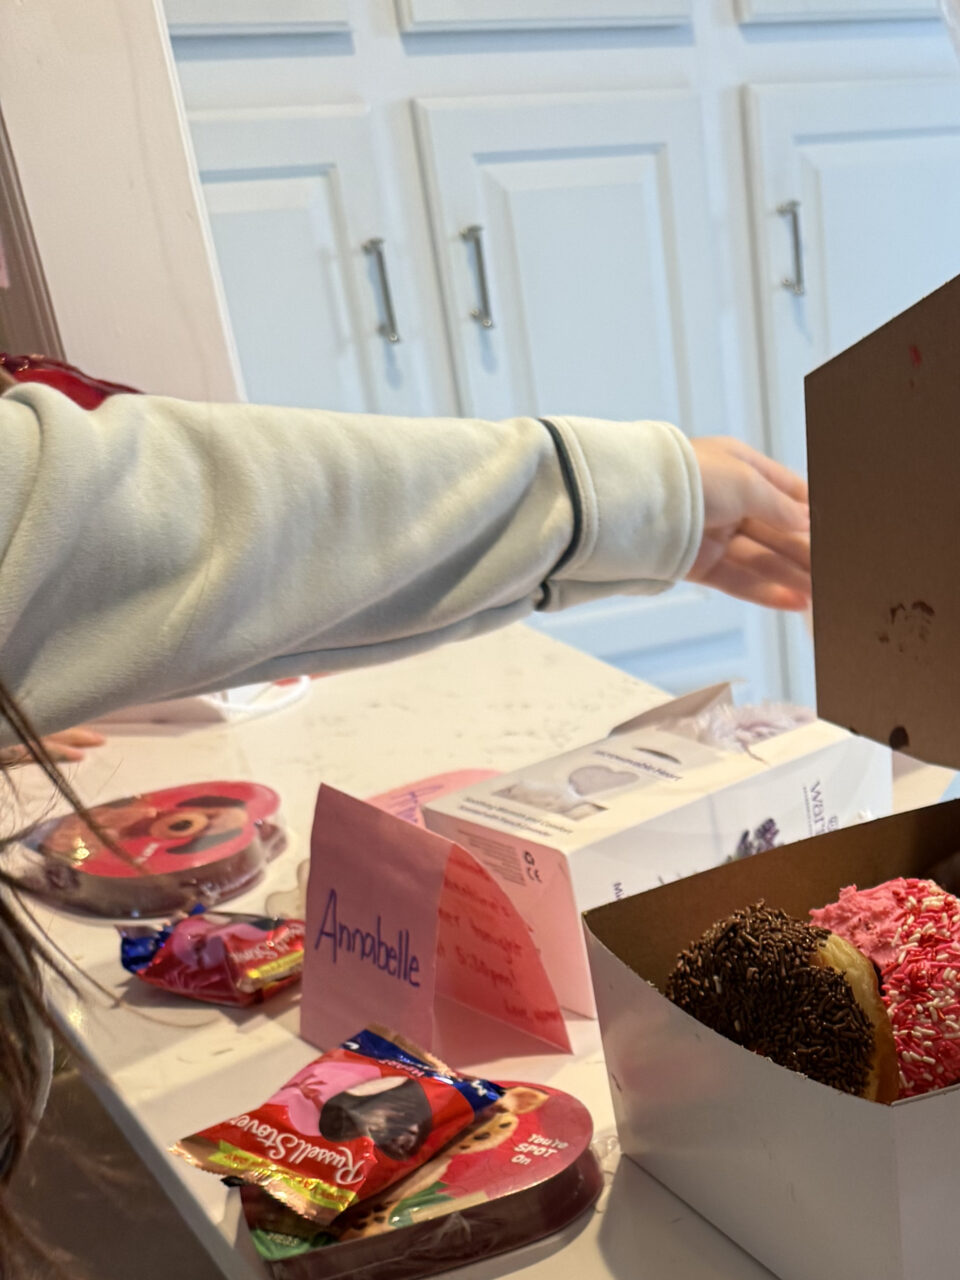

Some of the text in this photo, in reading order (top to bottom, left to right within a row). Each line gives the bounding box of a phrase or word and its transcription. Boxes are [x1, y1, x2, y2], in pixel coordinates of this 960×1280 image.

[314, 887, 421, 988] Annabelle
[288, 1146, 366, 1185] Russell
[513, 1142, 558, 1157] SPOT
